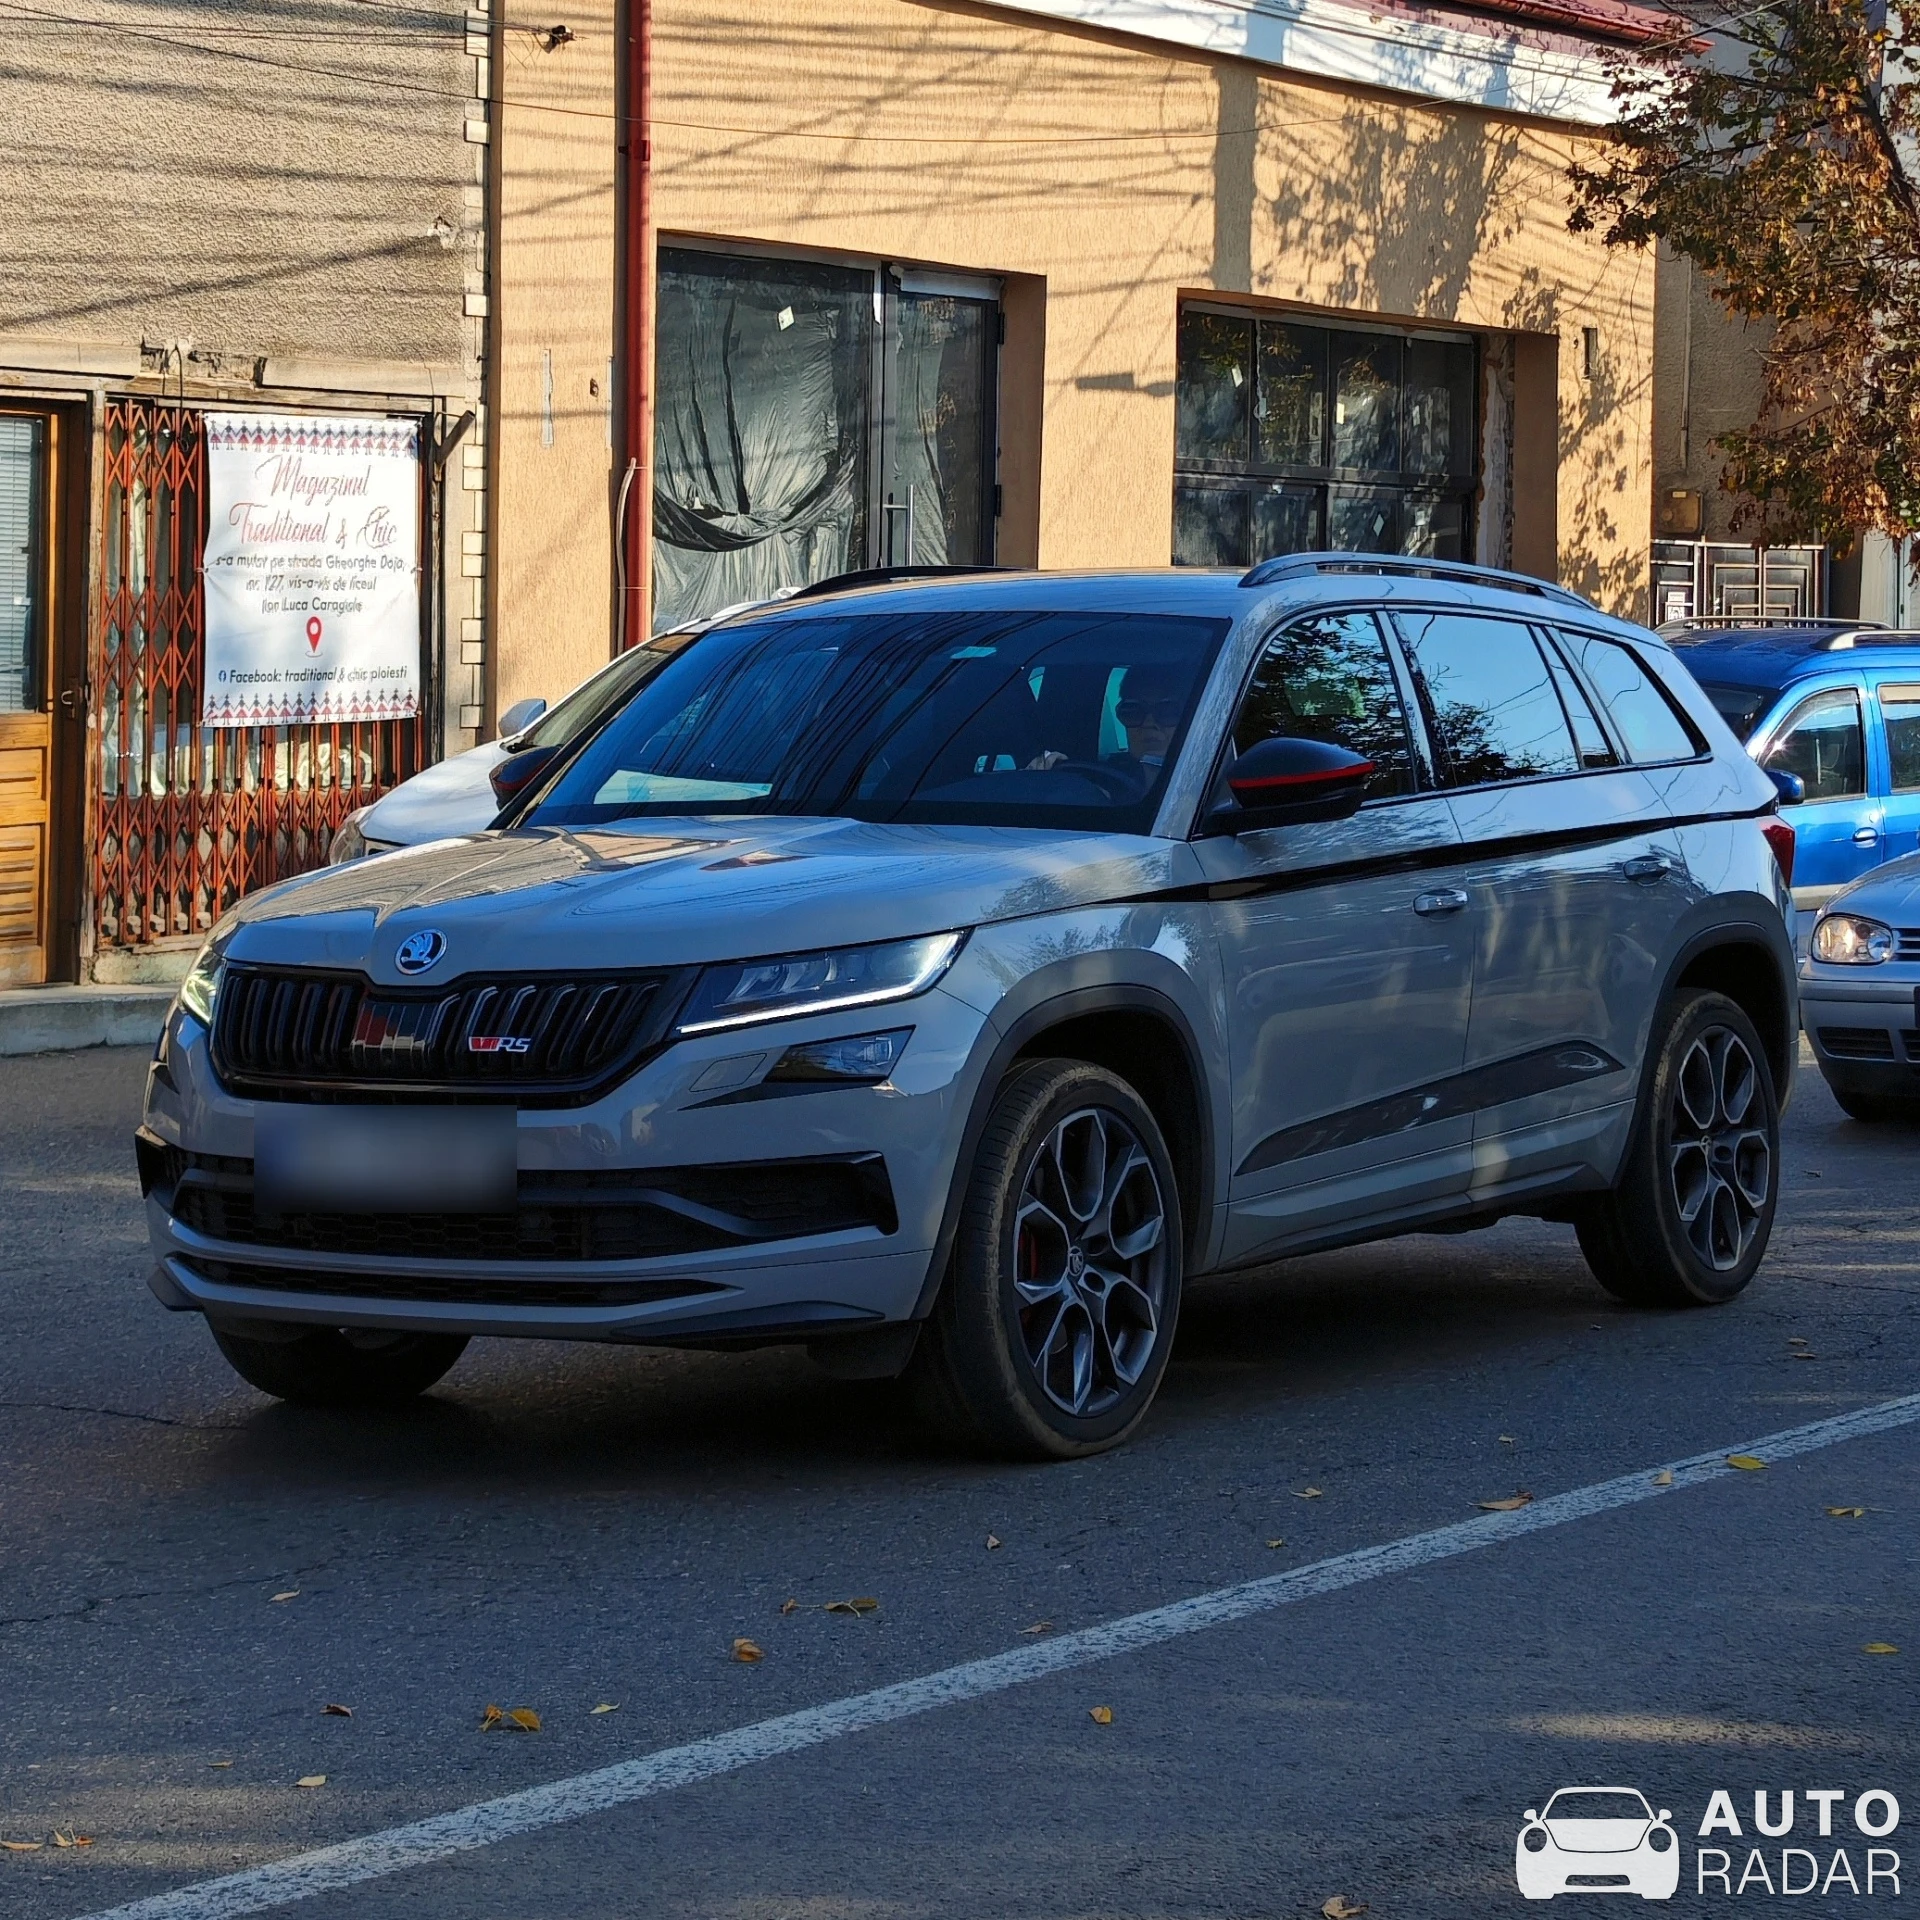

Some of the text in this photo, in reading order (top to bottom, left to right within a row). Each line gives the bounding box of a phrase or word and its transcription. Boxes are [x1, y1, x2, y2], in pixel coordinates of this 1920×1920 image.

[255, 454, 371, 506] Magazinul
[228, 502, 330, 544] Traditional
[356, 506, 397, 549] Chic
[215, 555, 234, 566] s-a
[270, 556, 285, 573] pe
[287, 553, 322, 568] strada
[325, 554, 377, 572] Gheorghe
[264, 574, 285, 593] 127,
[288, 574, 330, 591] vis-a-vis
[332, 576, 347, 591] de
[349, 576, 377, 591] liceul
[281, 597, 309, 613] Luca
[311, 596, 363, 618] Caragiale
[229, 665, 408, 684] Facebook: traditional & chic ploiesti
